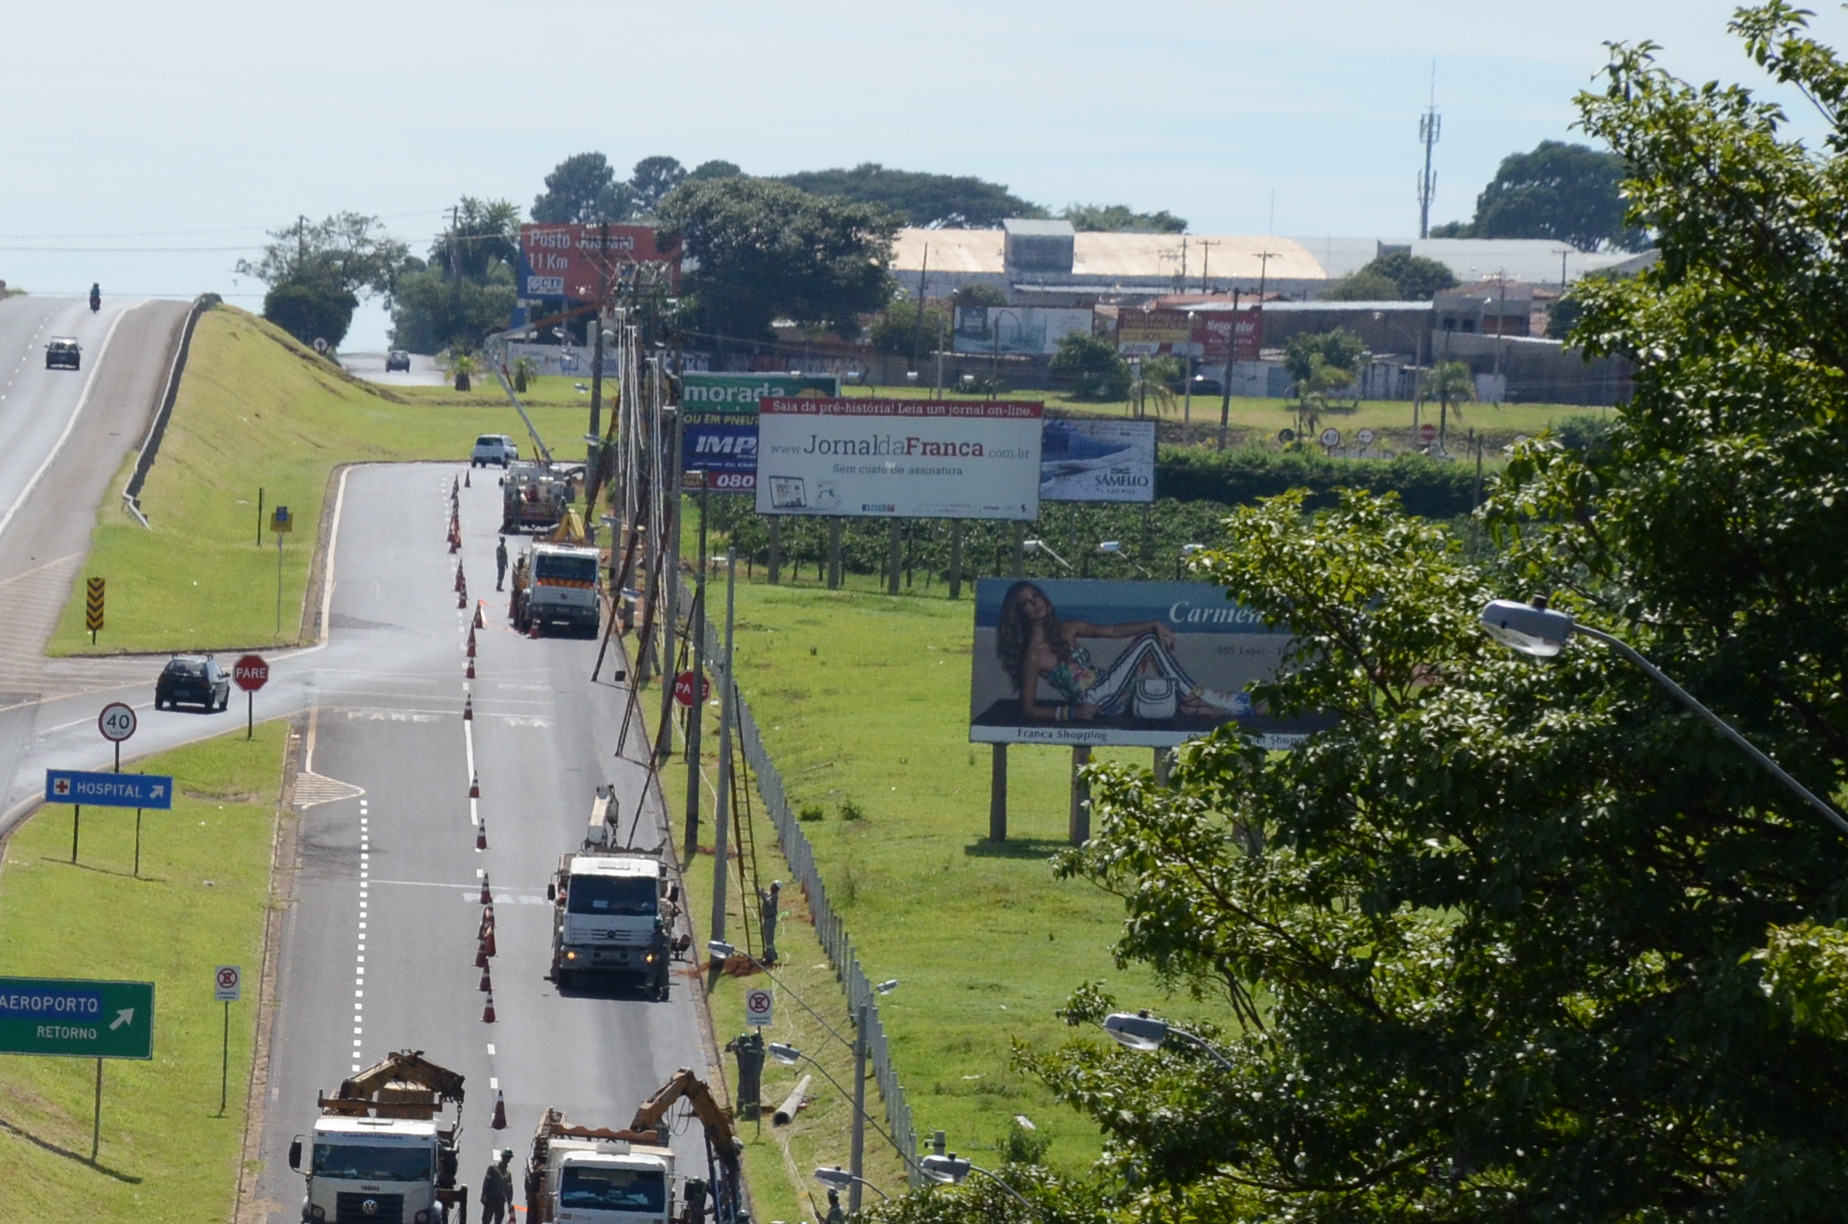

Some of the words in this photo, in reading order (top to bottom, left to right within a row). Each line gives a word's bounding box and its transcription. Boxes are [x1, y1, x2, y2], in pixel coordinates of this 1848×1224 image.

[530, 229, 570, 249] Posto
[683, 382, 785, 403] morada
[772, 401, 798, 412] Saia
[800, 402, 816, 412] da
[897, 403, 923, 414] Leia
[926, 405, 946, 415] um
[948, 403, 984, 416] jornal
[724, 415, 759, 426] PNEU
[695, 435, 758, 454] IMP
[832, 463, 856, 474] Sem
[858, 465, 888, 474] custo
[890, 464, 905, 475] de
[907, 465, 963, 476] assinatura
[1094, 473, 1149, 488] SAMELLO
[235, 667, 267, 680] PARE
[675, 682, 708, 696] PAE
[106, 714, 131, 730] 40
[1056, 729, 1108, 742] Shopping
[77, 781, 143, 799] HOSPITAL
[36, 1025, 97, 1040] RETORNO
